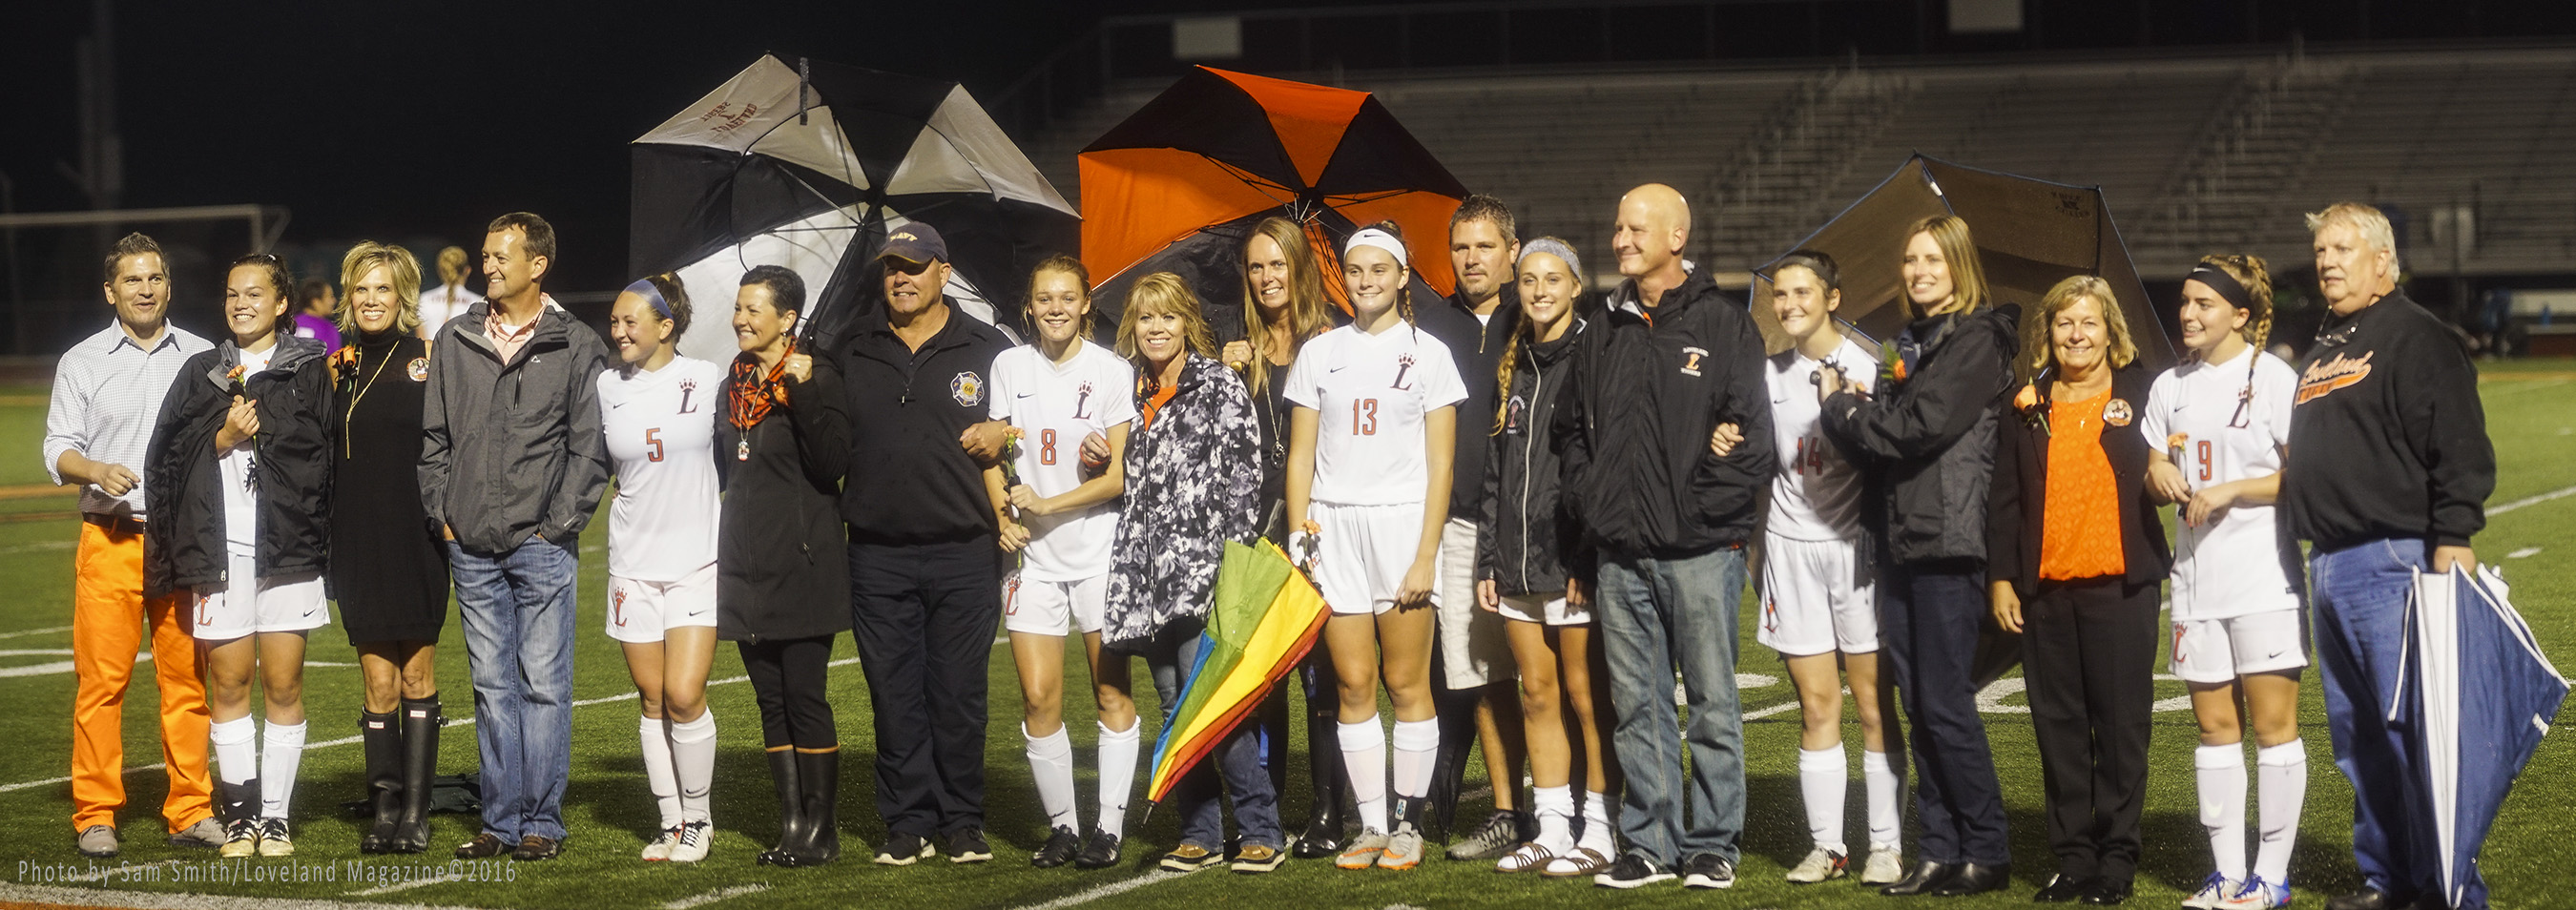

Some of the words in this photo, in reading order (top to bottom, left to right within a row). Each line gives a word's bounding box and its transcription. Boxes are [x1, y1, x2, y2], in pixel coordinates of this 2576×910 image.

[964, 383, 974, 394] 60
[1389, 362, 1413, 391] L
[676, 387, 698, 415] L
[1071, 391, 1092, 420] L
[1352, 398, 1378, 436] 13
[2226, 398, 2250, 429] L
[646, 427, 664, 463] 5
[1041, 428, 1057, 465] 8
[1797, 436, 1823, 476] 14
[2197, 440, 2212, 482] 9
